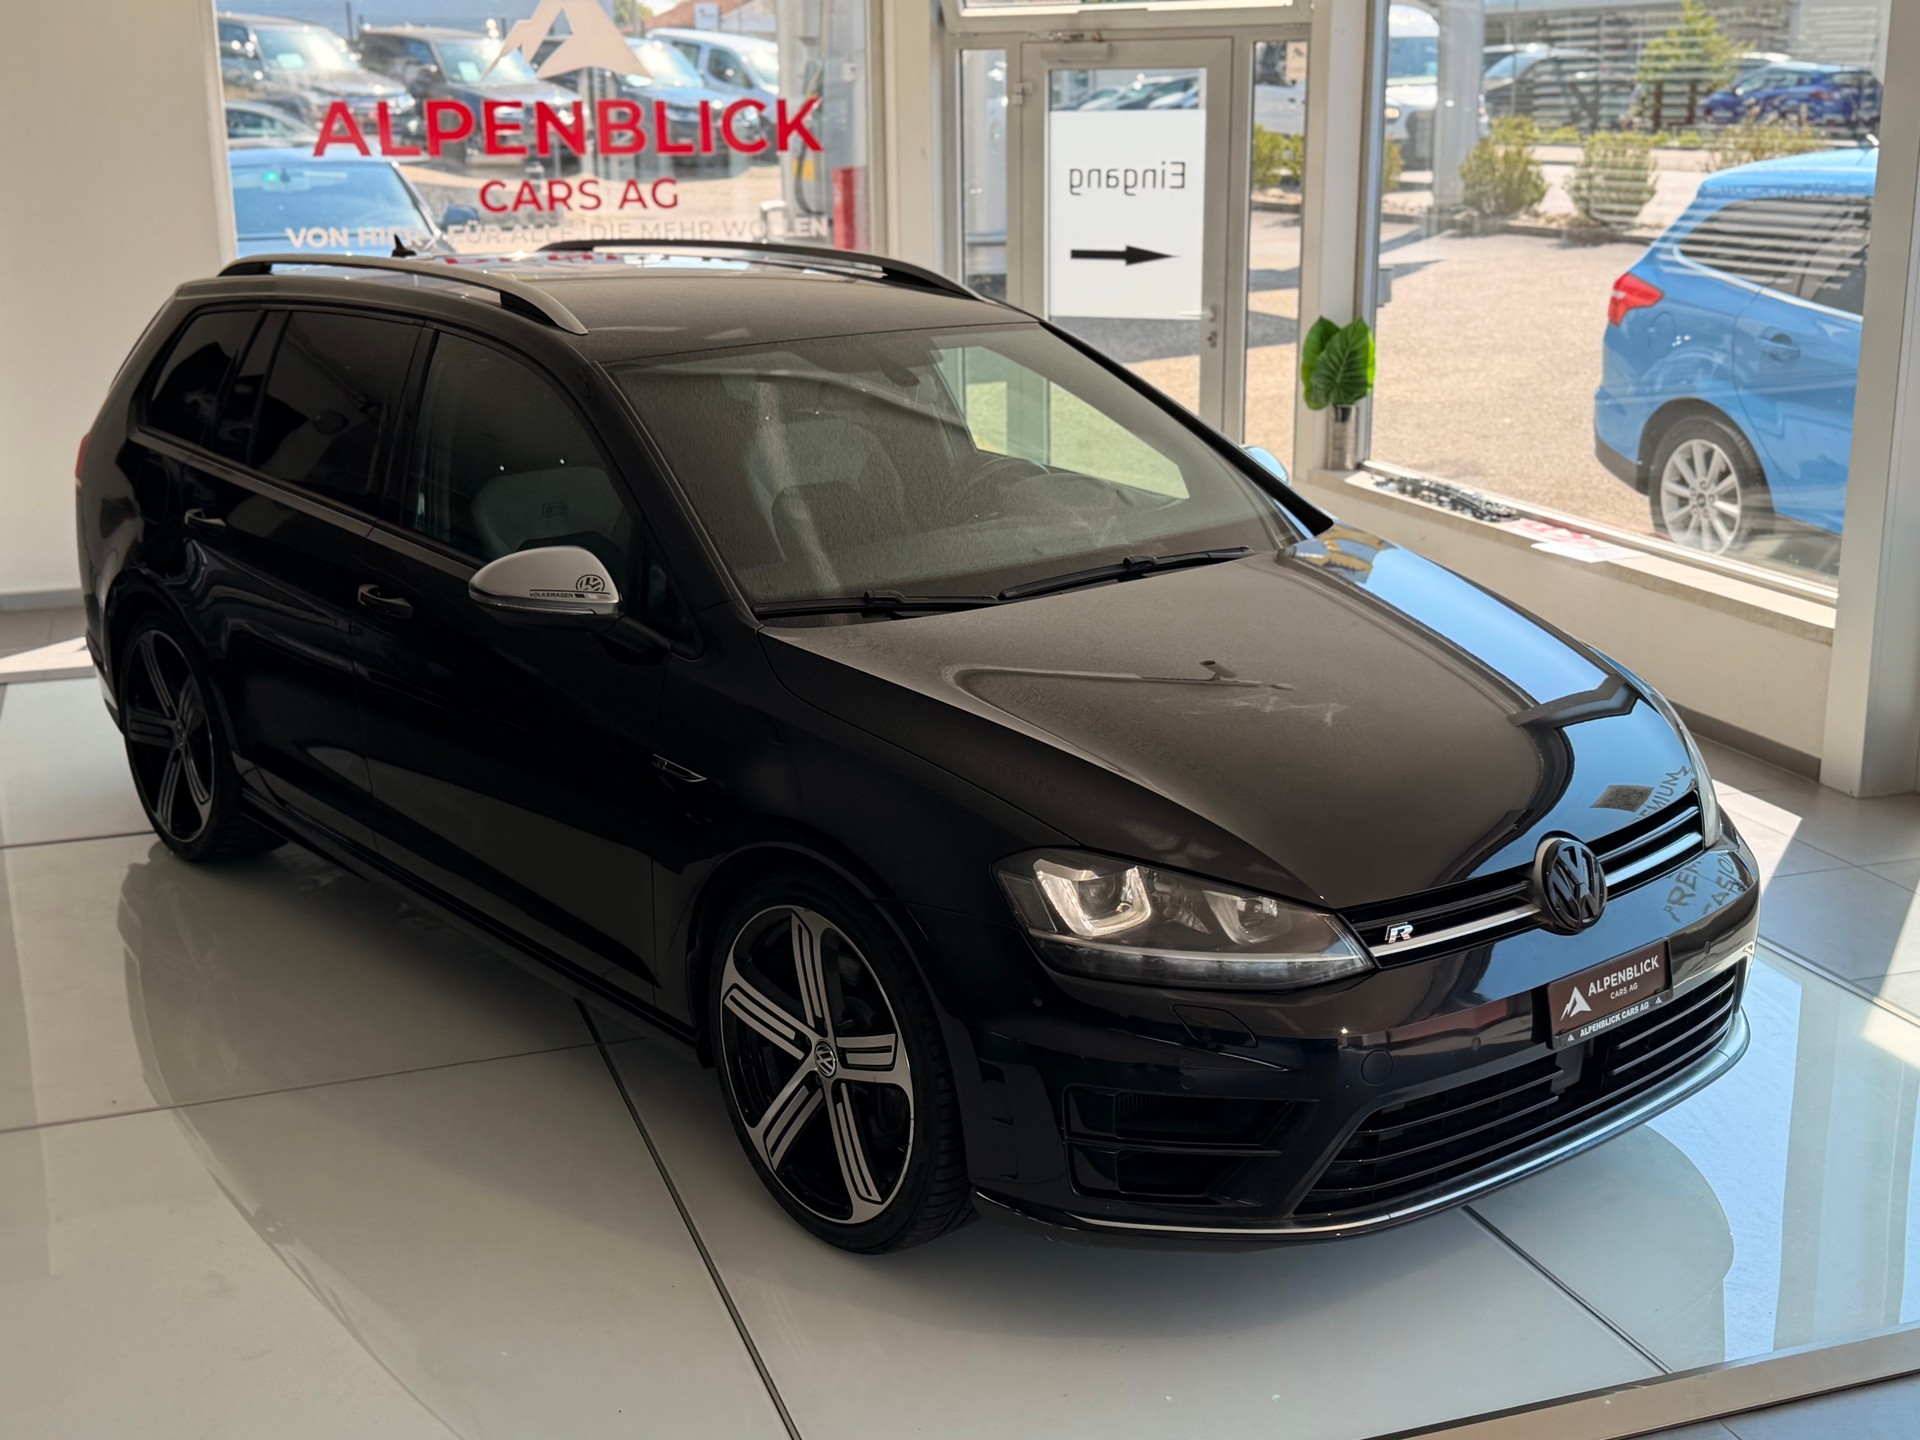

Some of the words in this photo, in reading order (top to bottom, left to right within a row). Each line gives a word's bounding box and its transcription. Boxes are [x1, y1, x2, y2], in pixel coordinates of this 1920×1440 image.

[313, 96, 824, 158] ALPENBLICK
[478, 178, 601, 214] CARS
[618, 176, 680, 211] AG
[285, 227, 350, 249] VON
[447, 220, 500, 244] FÜR
[590, 222, 631, 240] DIE
[641, 220, 714, 240] MEHR
[1588, 955, 1660, 997] ALPENBLICK
[1610, 987, 1628, 1000] CARS
[1628, 982, 1638, 992] AG
[1580, 1014, 1621, 1038] ALPENBLICK
[1621, 1005, 1639, 1020] CARS
[1639, 1001, 1650, 1012] AG
